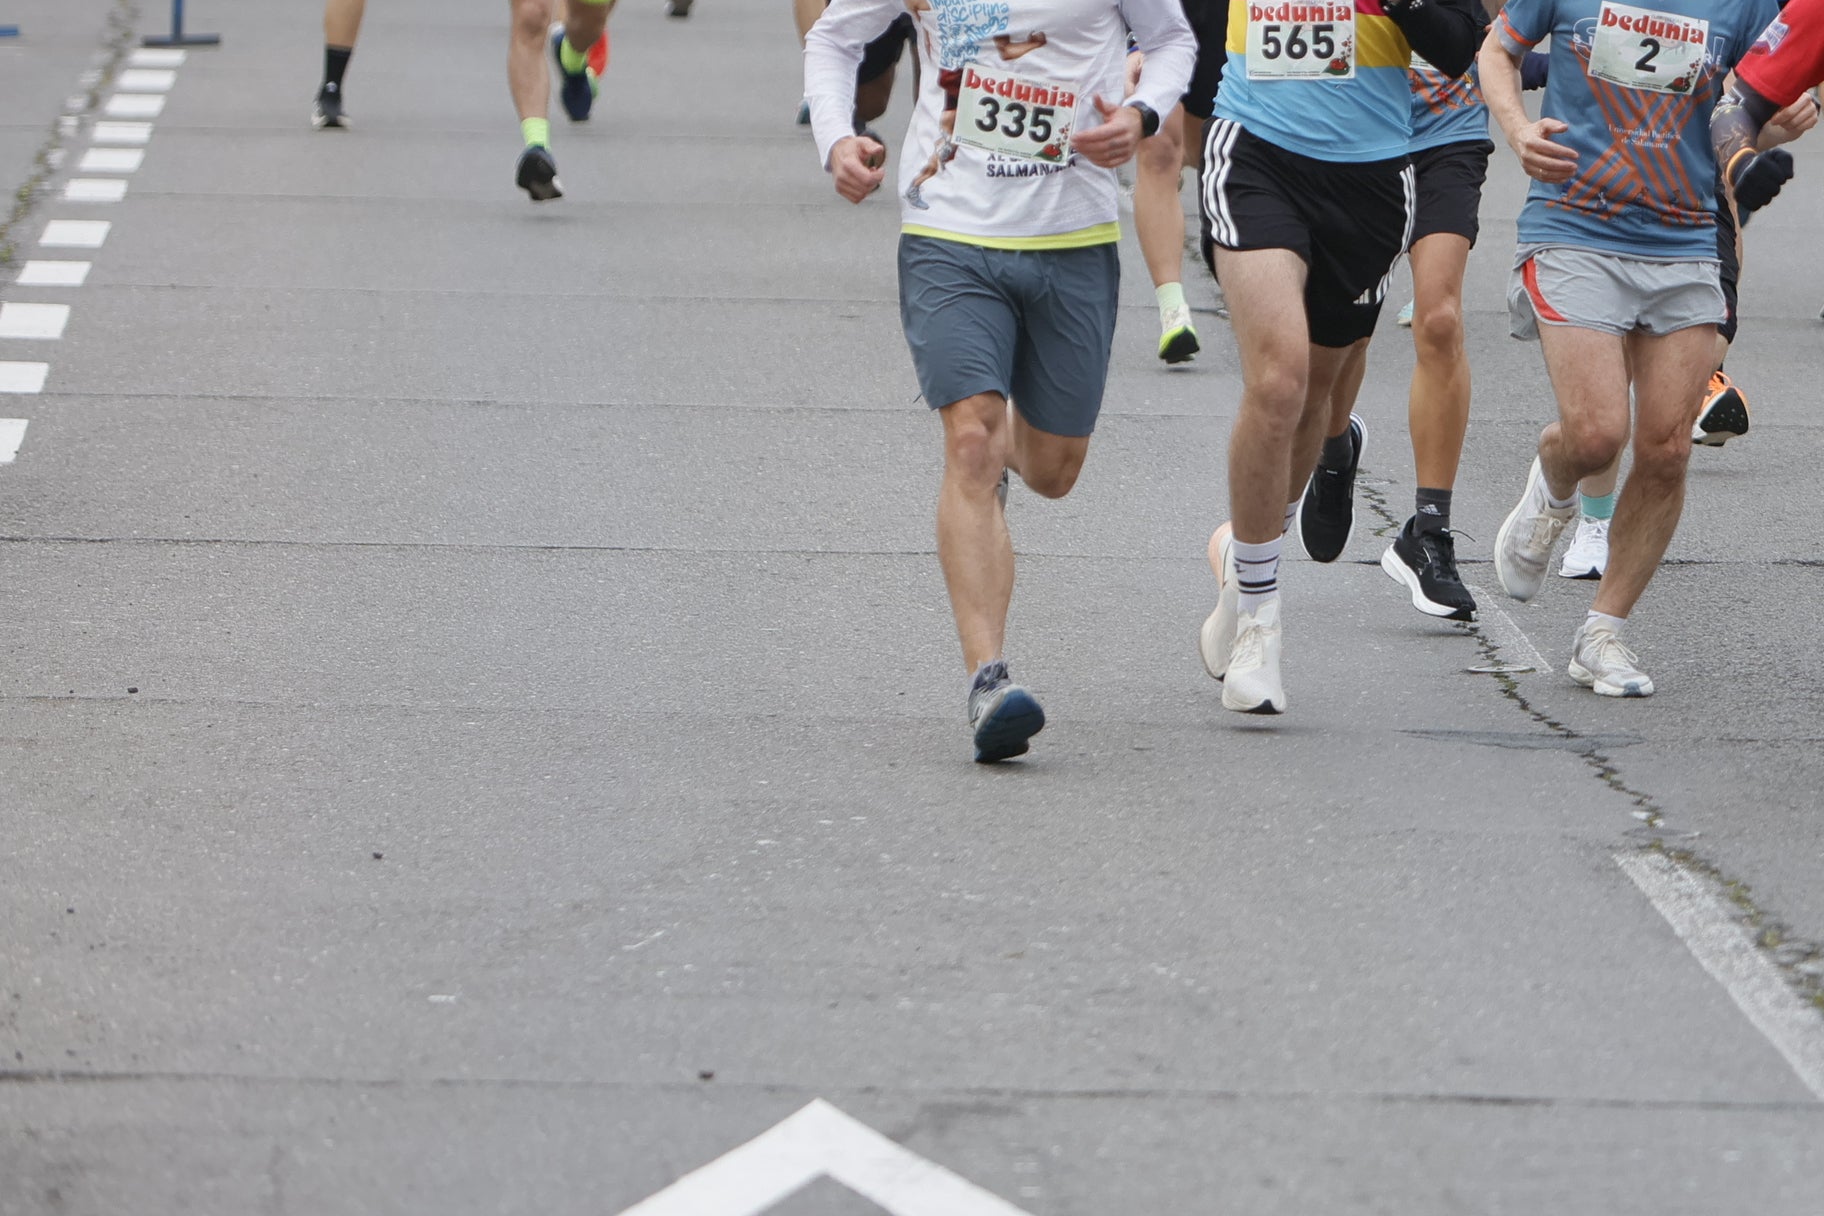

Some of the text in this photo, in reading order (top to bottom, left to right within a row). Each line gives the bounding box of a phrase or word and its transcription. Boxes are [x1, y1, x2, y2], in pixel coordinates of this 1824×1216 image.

[1250, 2, 1352, 23] bedunia
[1601, 7, 1705, 45] bedunia
[1262, 24, 1335, 60] 565
[1635, 38, 1660, 73] 2
[965, 68, 1076, 109] bedunia
[974, 96, 1055, 143] 335
